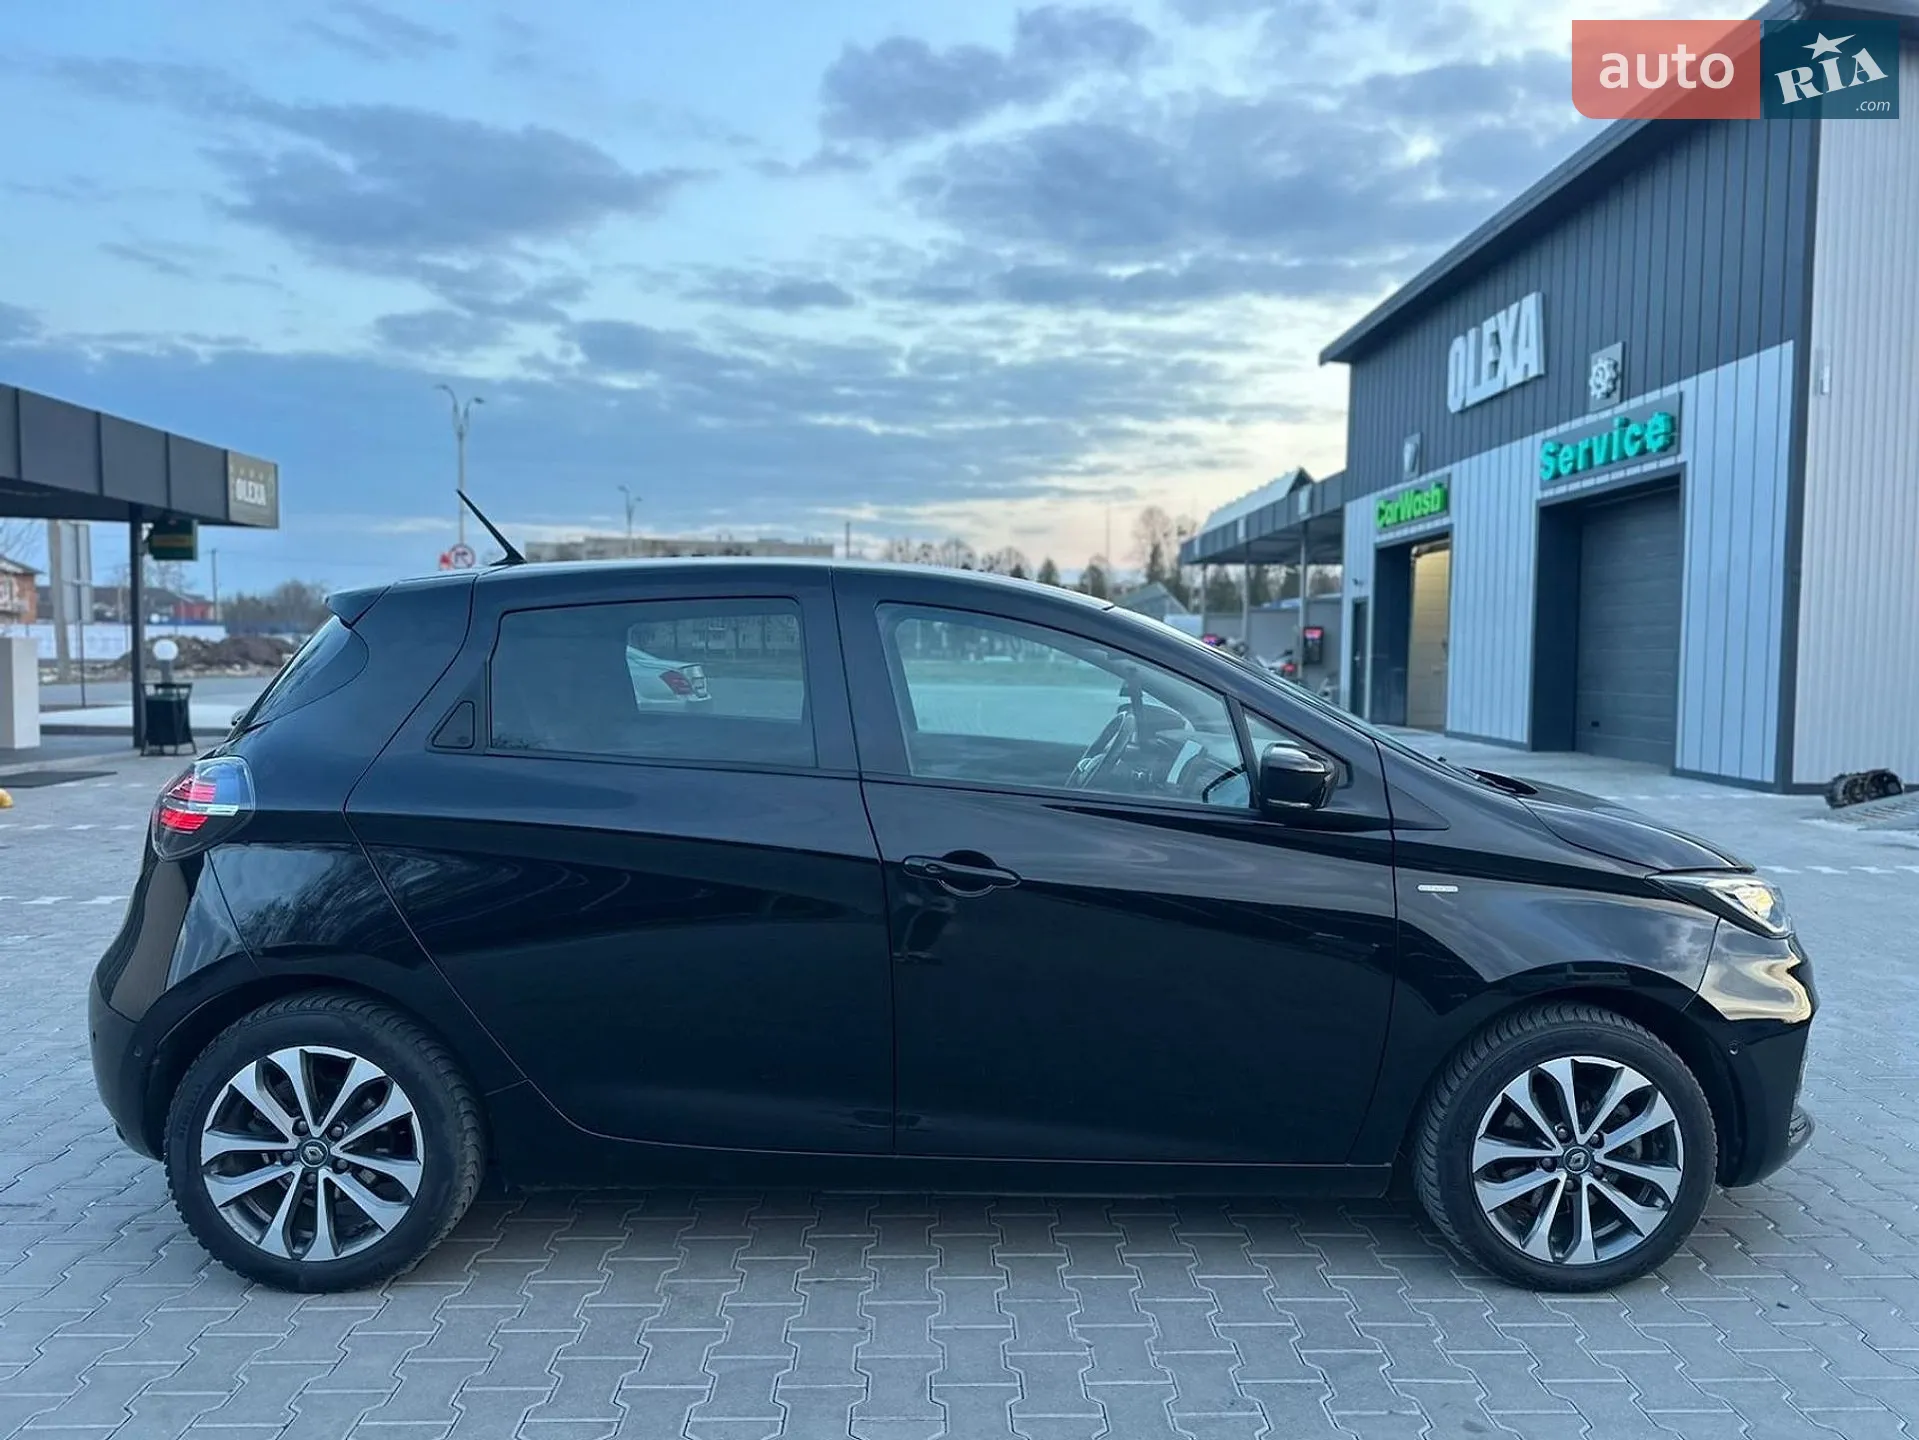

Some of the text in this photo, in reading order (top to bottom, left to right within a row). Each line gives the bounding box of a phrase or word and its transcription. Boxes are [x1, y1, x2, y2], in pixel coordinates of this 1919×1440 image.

[1447, 291, 1545, 413] OLEXA
[1540, 411, 1673, 480] Service
[235, 477, 266, 506] OLEXA
[1375, 481, 1447, 530] CarWash
